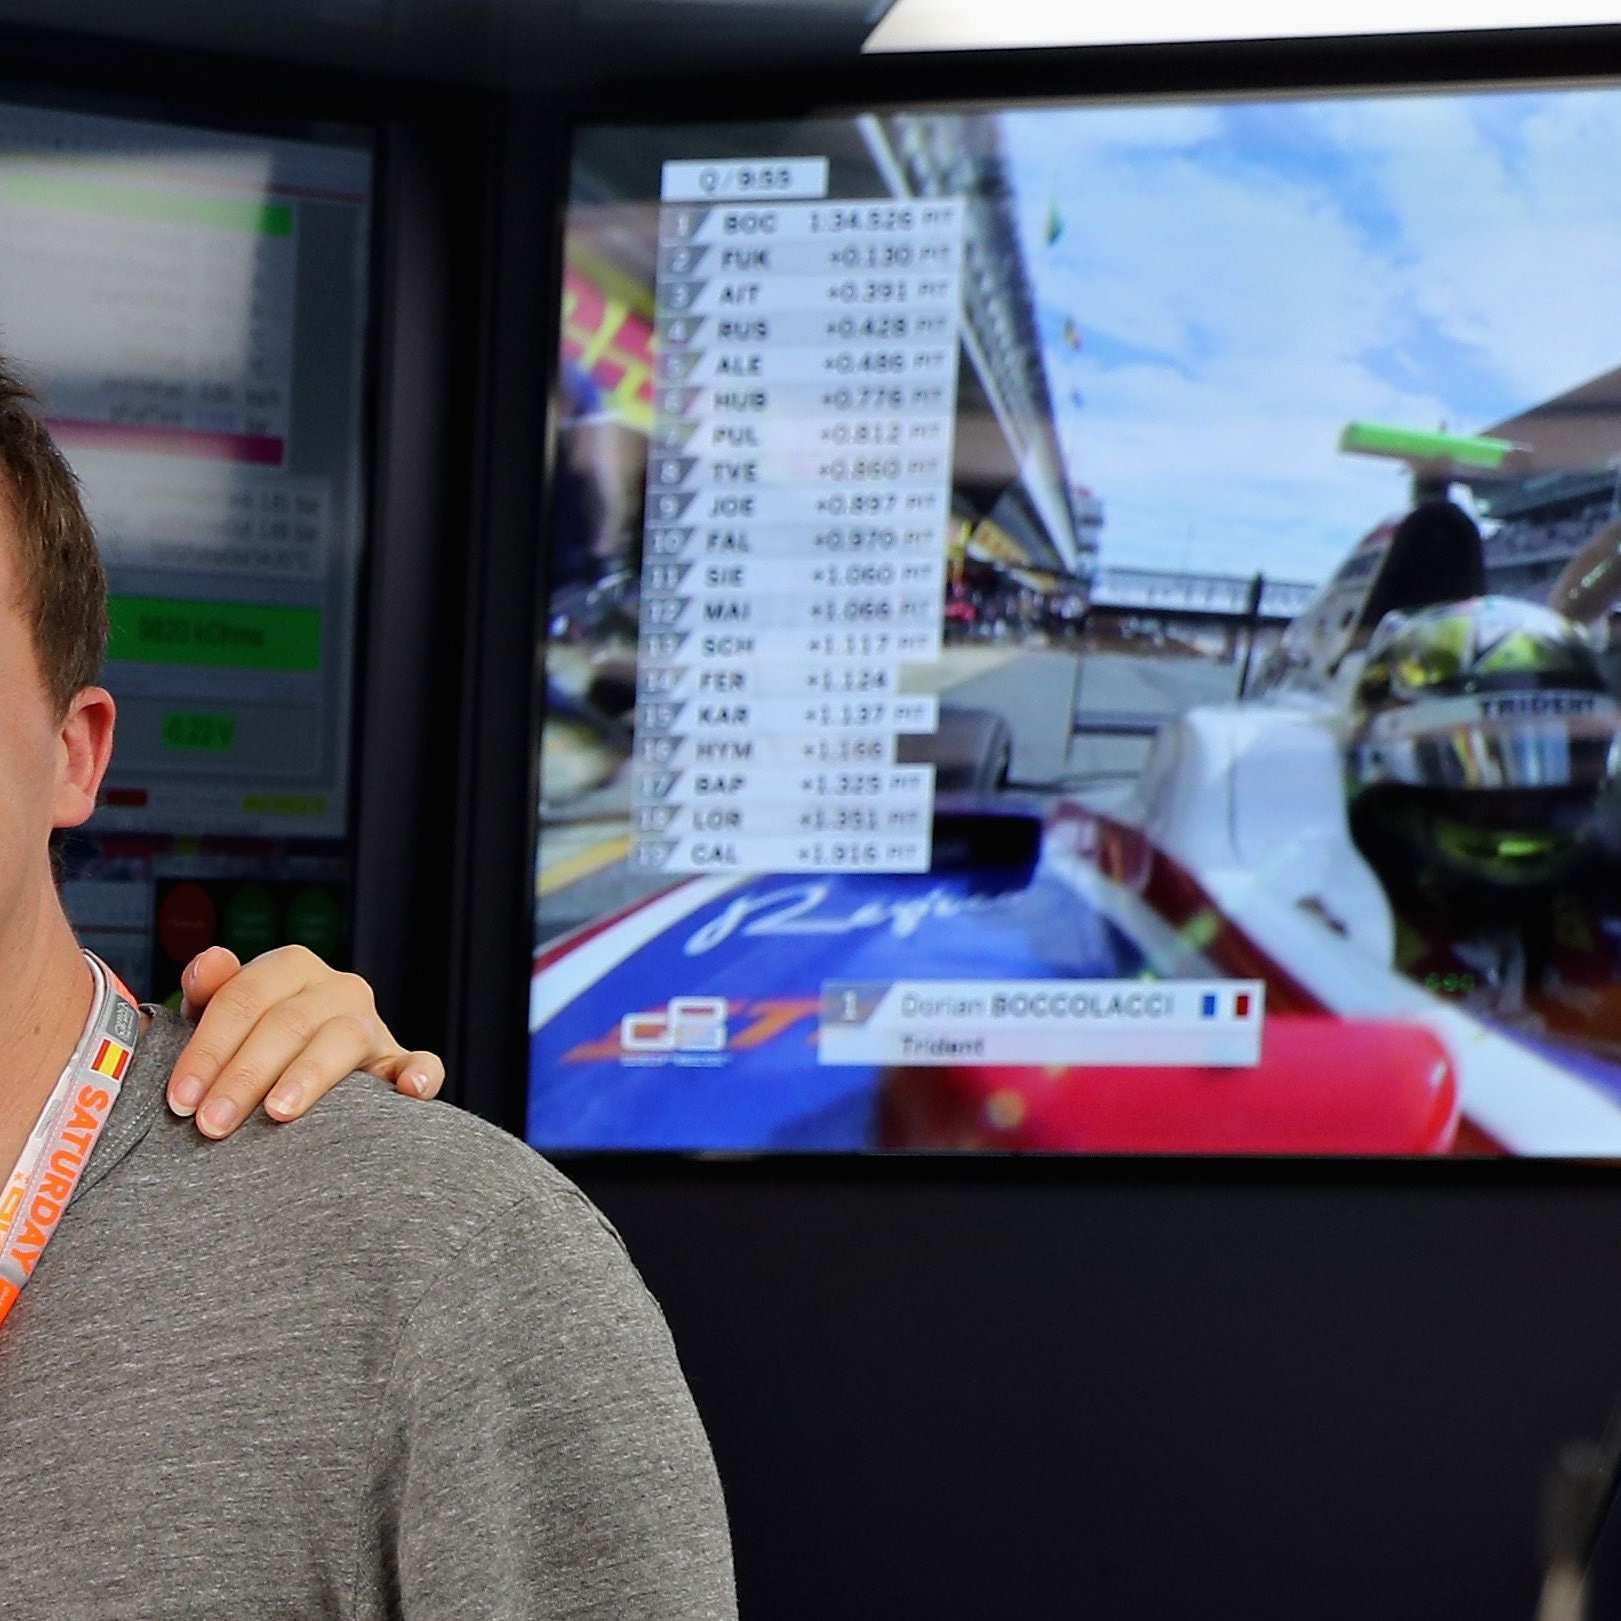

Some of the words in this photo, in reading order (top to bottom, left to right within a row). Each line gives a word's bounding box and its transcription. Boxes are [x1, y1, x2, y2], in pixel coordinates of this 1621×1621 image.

[723, 213, 778, 233] BOC
[719, 283, 758, 303] AIT
[716, 353, 760, 373] ALE
[713, 458, 756, 478] TVE
[707, 529, 749, 549] FAL
[704, 599, 750, 619] MAI
[700, 669, 744, 689] FER
[699, 704, 749, 724] KAR
[694, 809, 741, 829] LOR
[691, 844, 738, 864] CAL
[900, 993, 985, 1019] Dorian
[990, 993, 1176, 1019] BOCCOLACCI
[900, 1036, 985, 1057] Trident
[10, 1084, 110, 1277] SATURDAY
